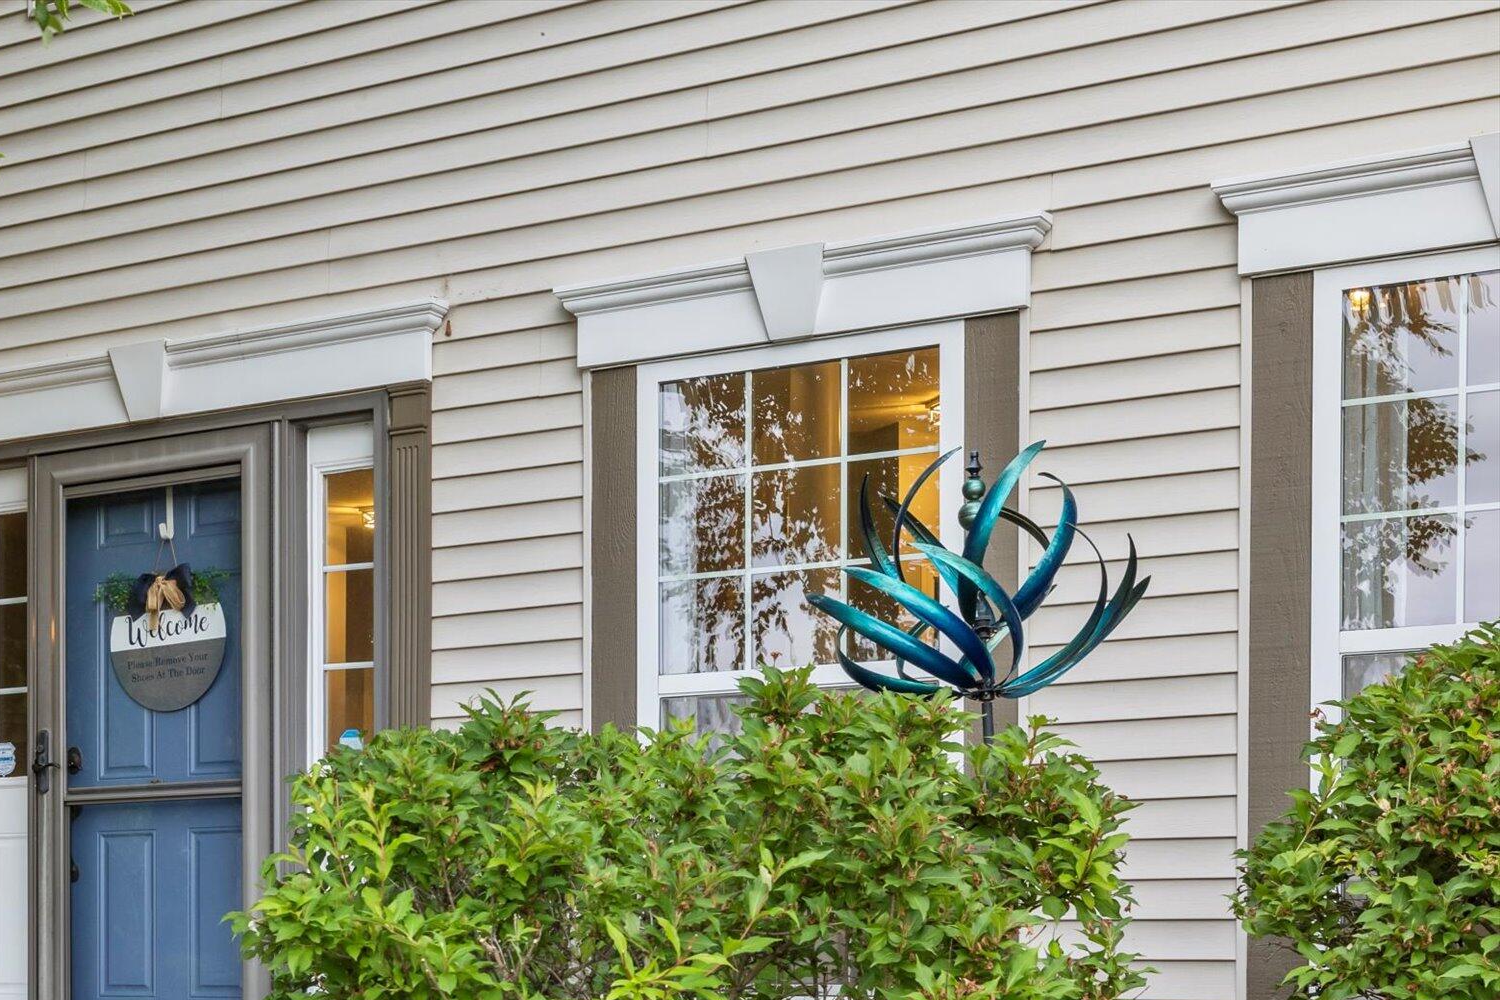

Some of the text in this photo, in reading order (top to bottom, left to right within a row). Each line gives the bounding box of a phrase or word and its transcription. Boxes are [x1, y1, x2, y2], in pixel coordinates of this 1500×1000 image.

[127, 652, 209, 671] Please Remove Your
[131, 666, 206, 683] Shoes At The Door
